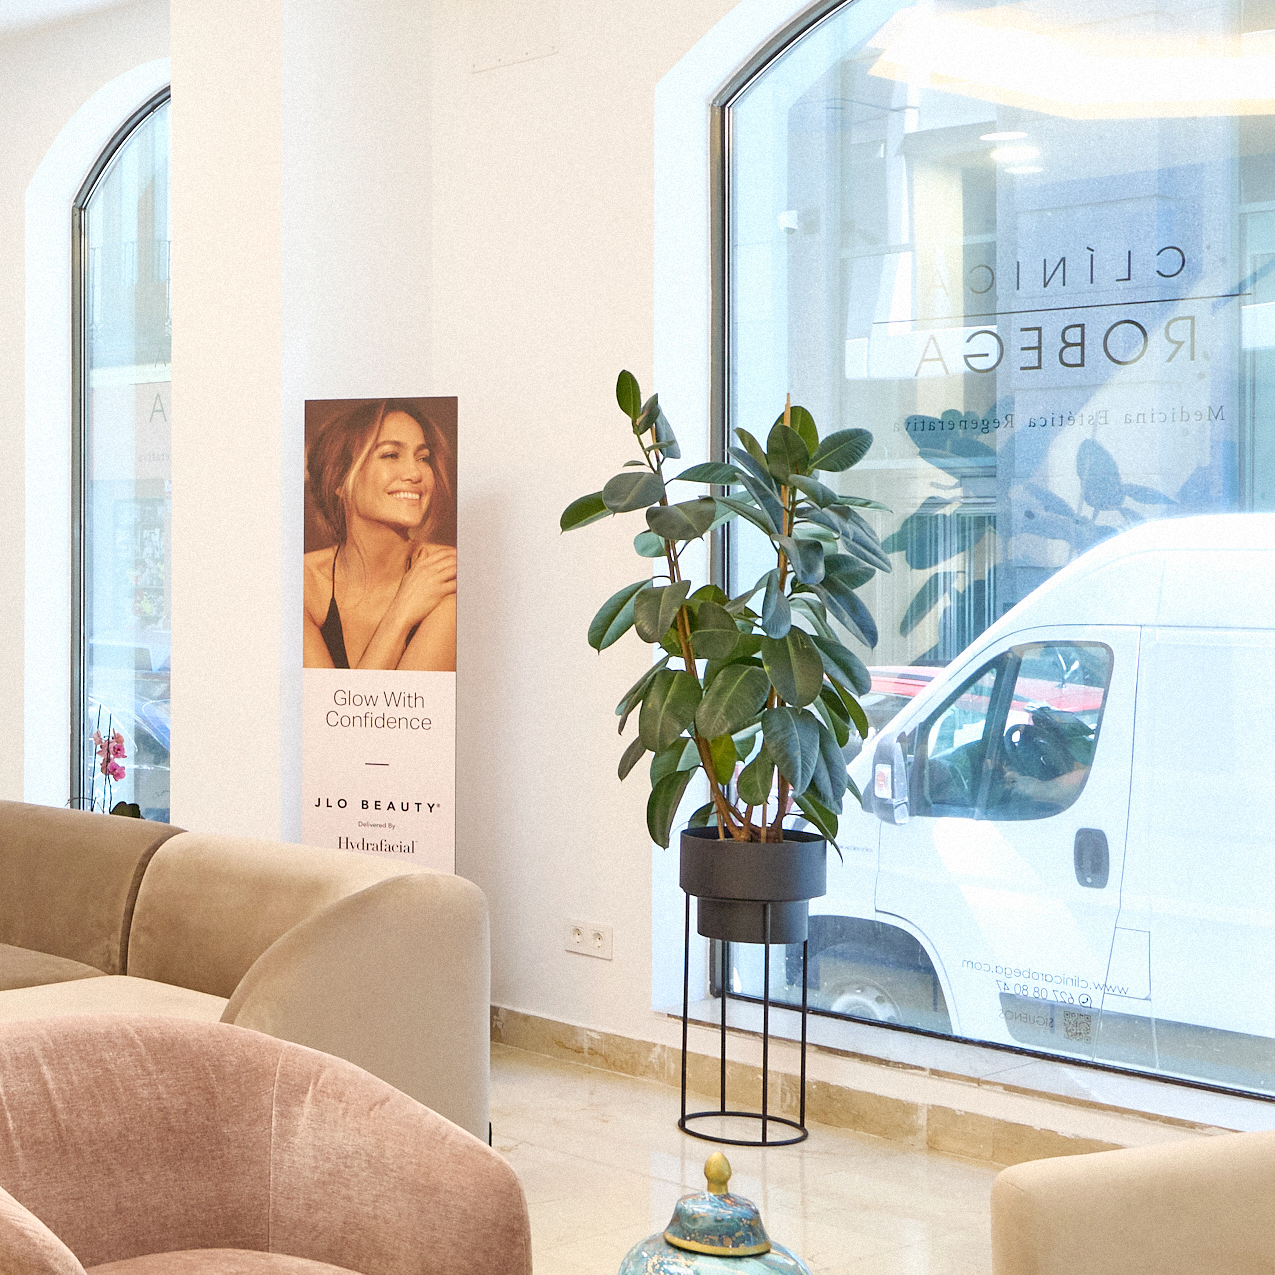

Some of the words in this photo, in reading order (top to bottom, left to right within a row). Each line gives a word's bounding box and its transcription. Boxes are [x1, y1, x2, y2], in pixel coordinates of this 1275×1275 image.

[333, 689, 378, 706] Glow
[383, 691, 424, 708] With
[325, 710, 431, 730] Confidence
[314, 797, 347, 808] JLO
[357, 820, 386, 829] Delivered
[387, 821, 395, 830] By
[337, 836, 415, 853] Hydrafacial
